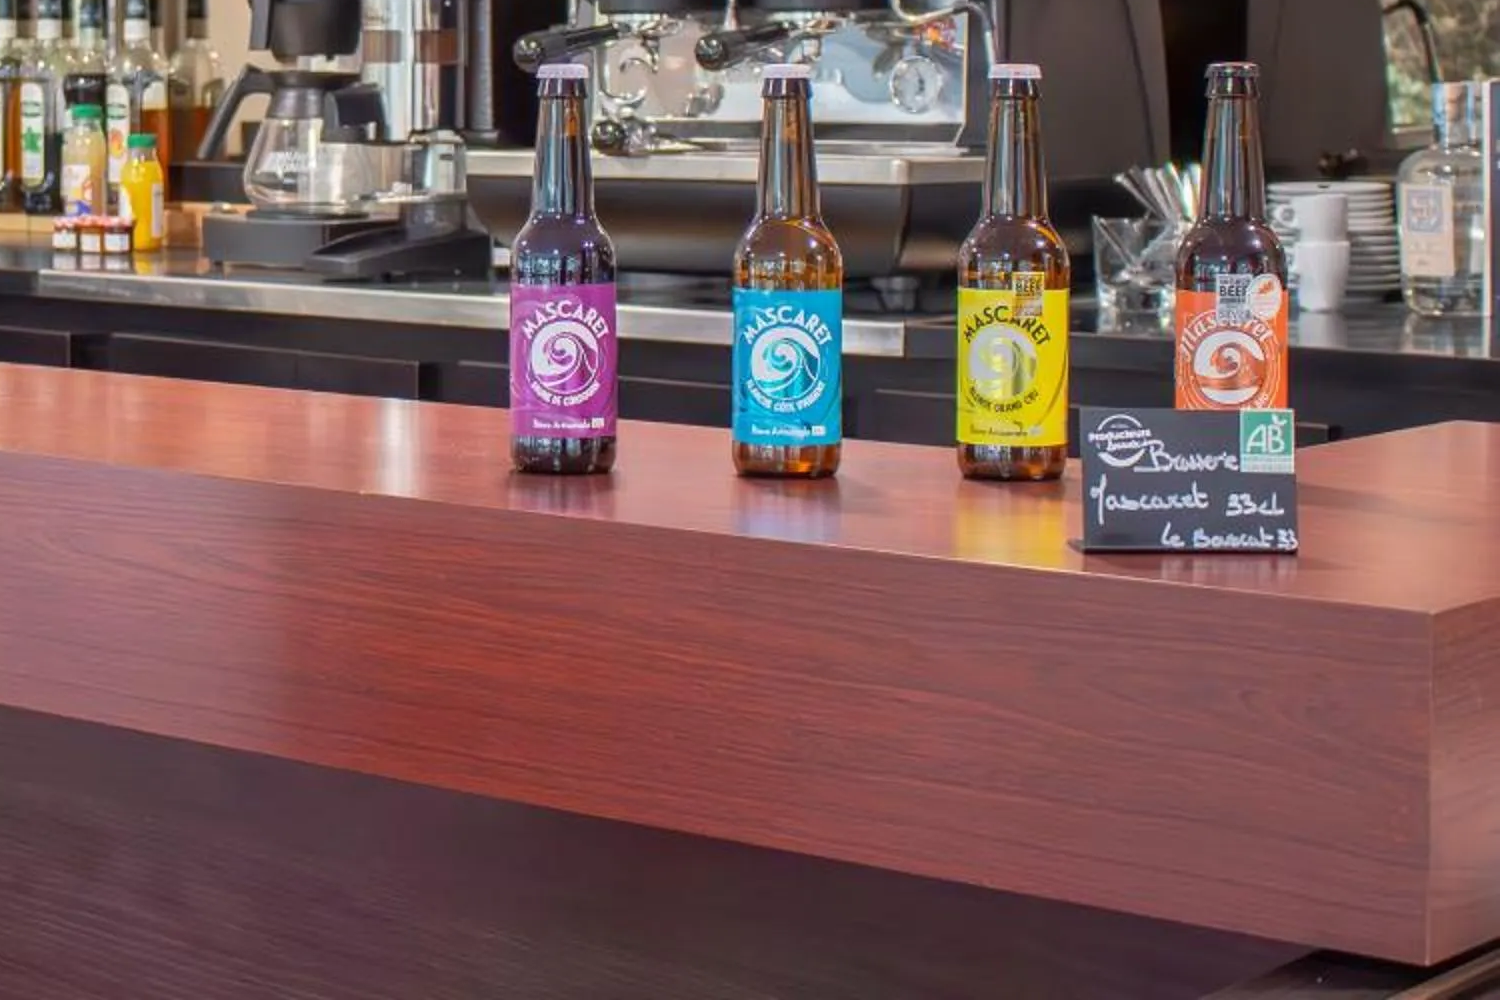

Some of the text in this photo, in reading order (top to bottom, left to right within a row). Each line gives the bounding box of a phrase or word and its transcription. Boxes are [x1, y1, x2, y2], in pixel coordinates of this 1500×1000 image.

[521, 299, 610, 340] MASCARET
[743, 305, 833, 346] MASCARET
[964, 305, 1051, 346] MASCARET
[1246, 423, 1285, 454] AB
